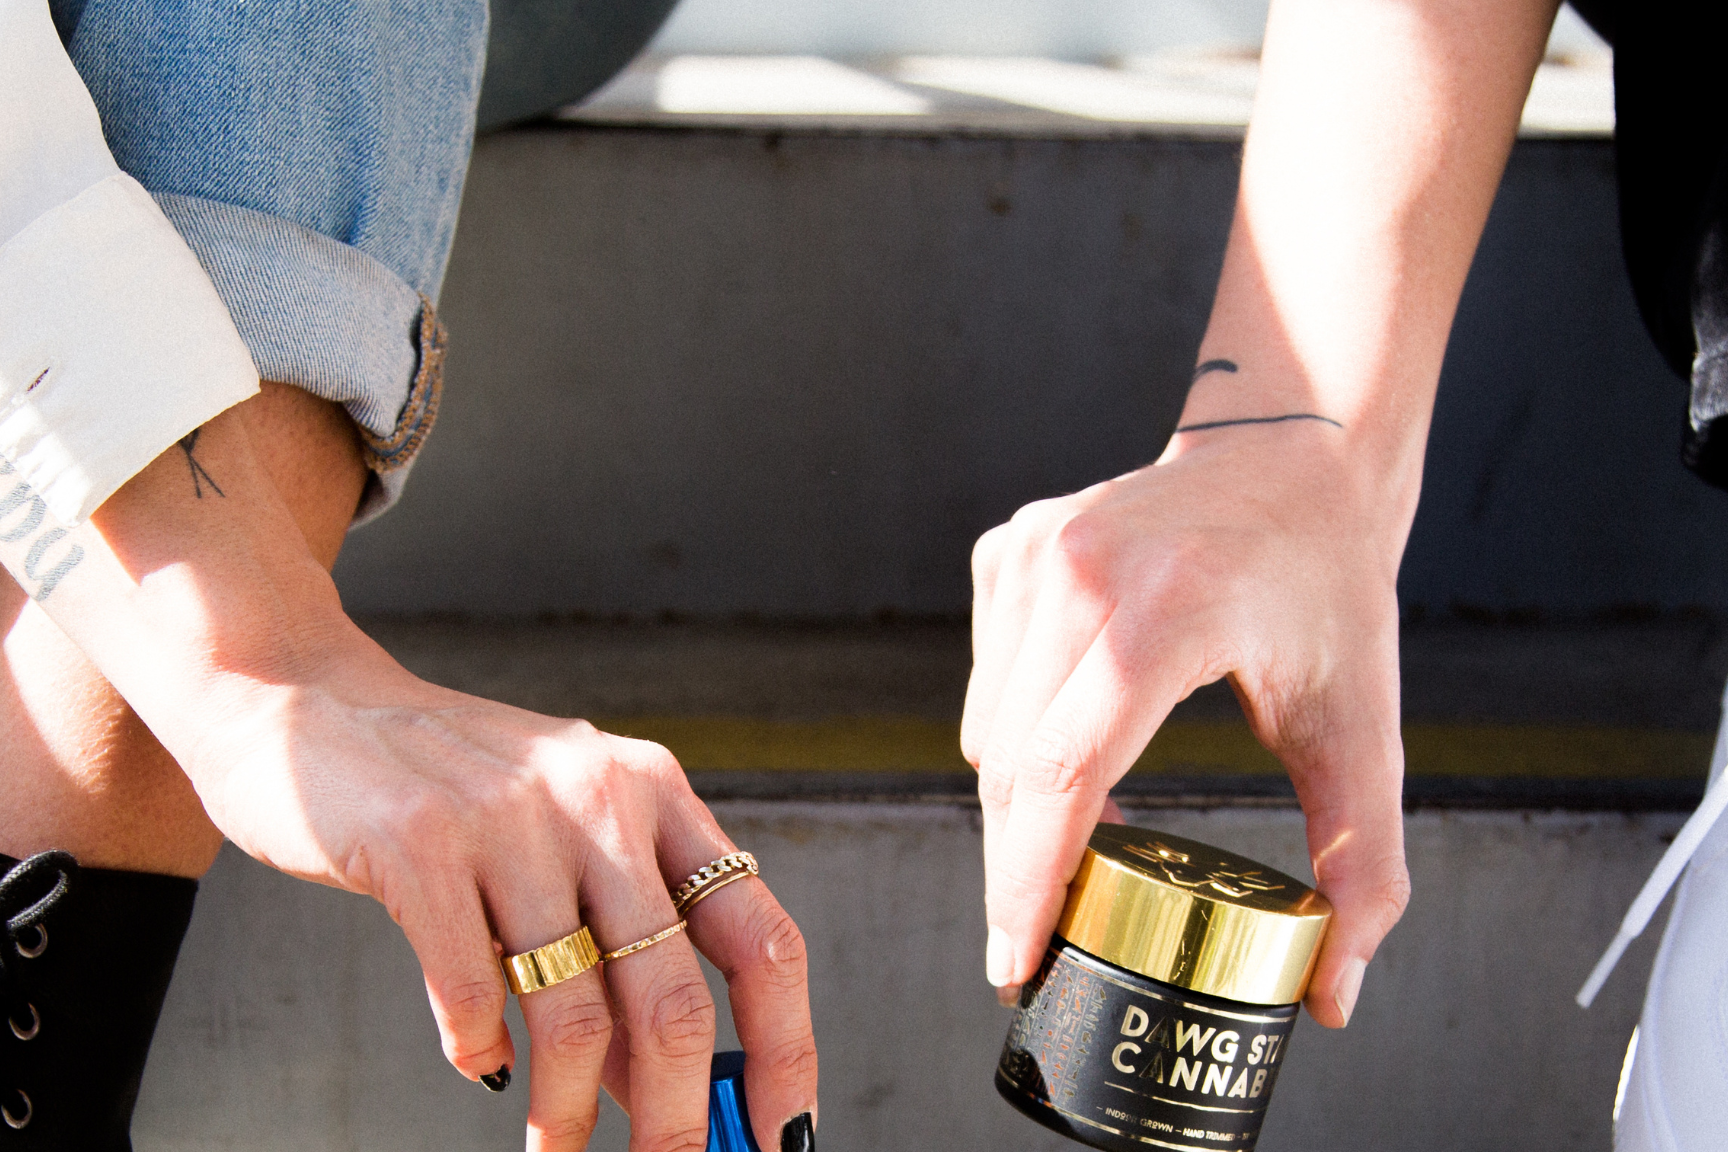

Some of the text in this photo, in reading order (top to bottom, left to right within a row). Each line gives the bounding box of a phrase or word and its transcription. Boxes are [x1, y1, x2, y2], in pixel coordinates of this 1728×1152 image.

[1120, 1004, 1240, 1063] DAWG
[1140, 1118, 1174, 1133] GROWN
[1182, 1127, 1204, 1139] HAND
